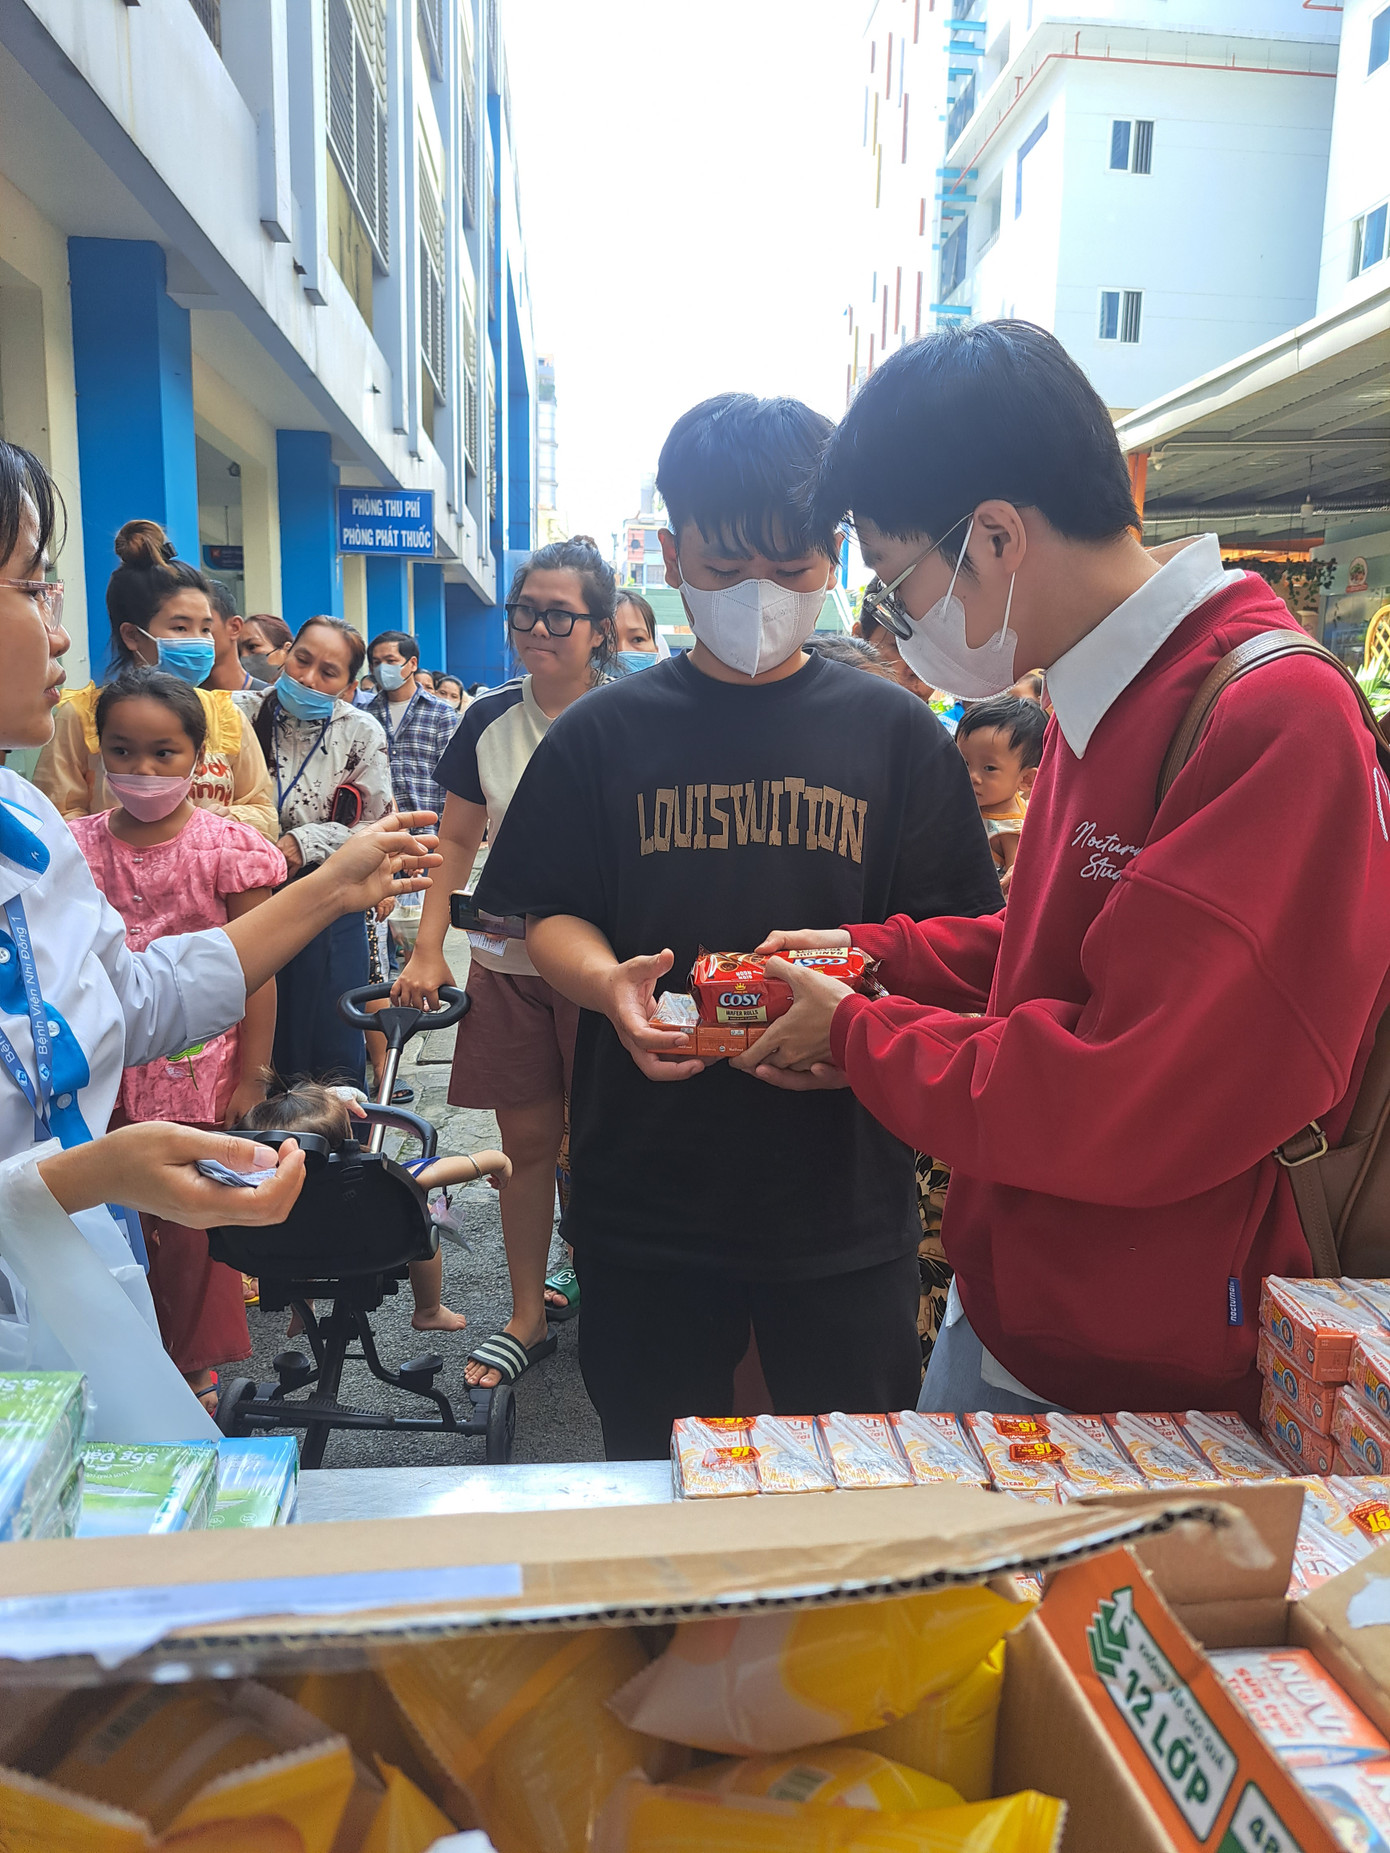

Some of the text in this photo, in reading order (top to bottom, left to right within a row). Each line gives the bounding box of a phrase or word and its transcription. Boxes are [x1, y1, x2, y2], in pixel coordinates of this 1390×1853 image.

[352, 494, 421, 518] PHÒNG THU PHÍ
[343, 523, 431, 549] PHÒNG PHÁT THUỐC
[637, 777, 868, 864] LOUISVUITTON
[17, 926, 31, 960] Đồng
[25, 963, 36, 985] Nhi
[793, 957, 849, 967] COSY
[30, 988, 43, 1016] Viện
[719, 992, 762, 1007] COSY
[0, 1034, 16, 1063] Bện
[35, 1020, 49, 1055] Bệnh
[1018, 1421, 1038, 1433] 15
[1034, 1443, 1053, 1456] 15
[1366, 1509, 1390, 1533] 15
[1126, 1669, 1210, 1804] 12 LỚP
